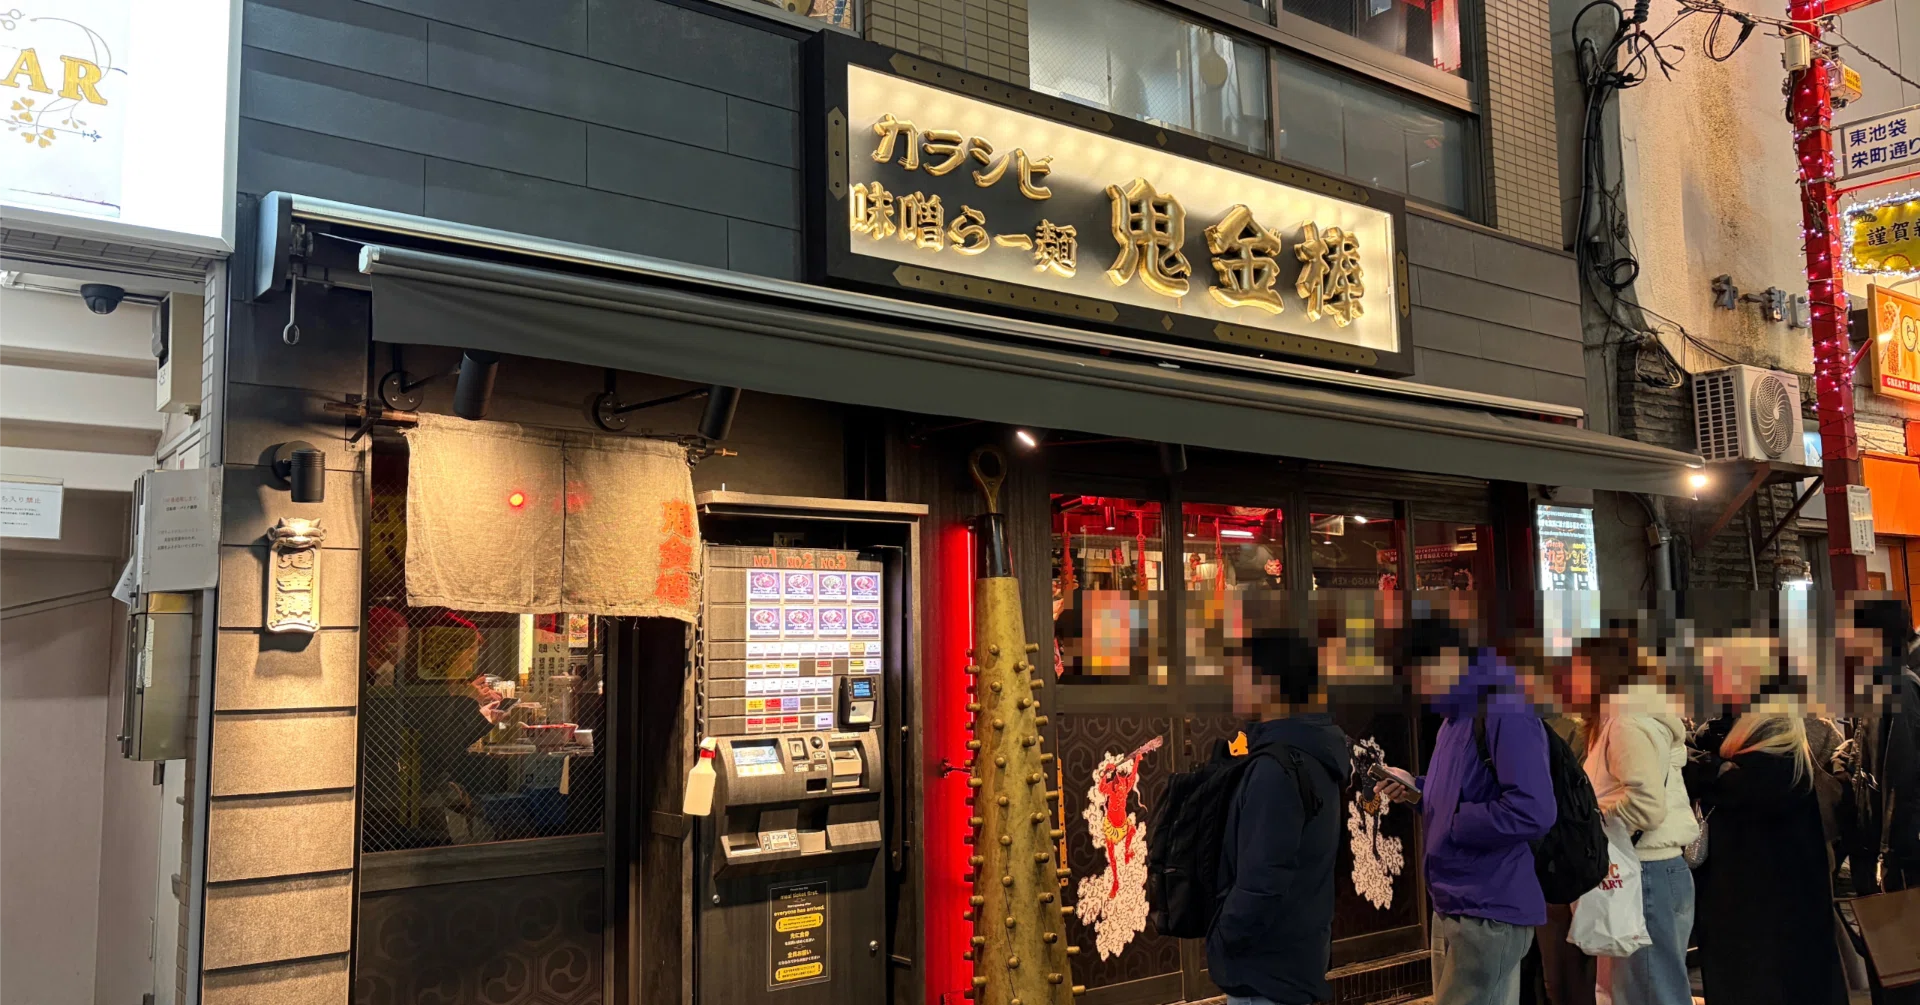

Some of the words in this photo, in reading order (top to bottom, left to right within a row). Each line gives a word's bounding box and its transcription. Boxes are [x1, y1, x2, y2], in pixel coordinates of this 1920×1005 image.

[1849, 118, 1907, 147] 東池袋
[872, 112, 1054, 201] カラシビ
[1851, 137, 1920, 169] 栄町通り
[849, 180, 1078, 279] 味噌らー麺
[1104, 176, 1366, 329] 鬼金棒
[654, 496, 694, 606] 鬼金棒
[753, 548, 778, 568] NO.1
[785, 552, 814, 569] NO.2
[820, 553, 847, 570] NO.3
[1598, 879, 1624, 891] ART
[774, 909, 796, 917] everyone
